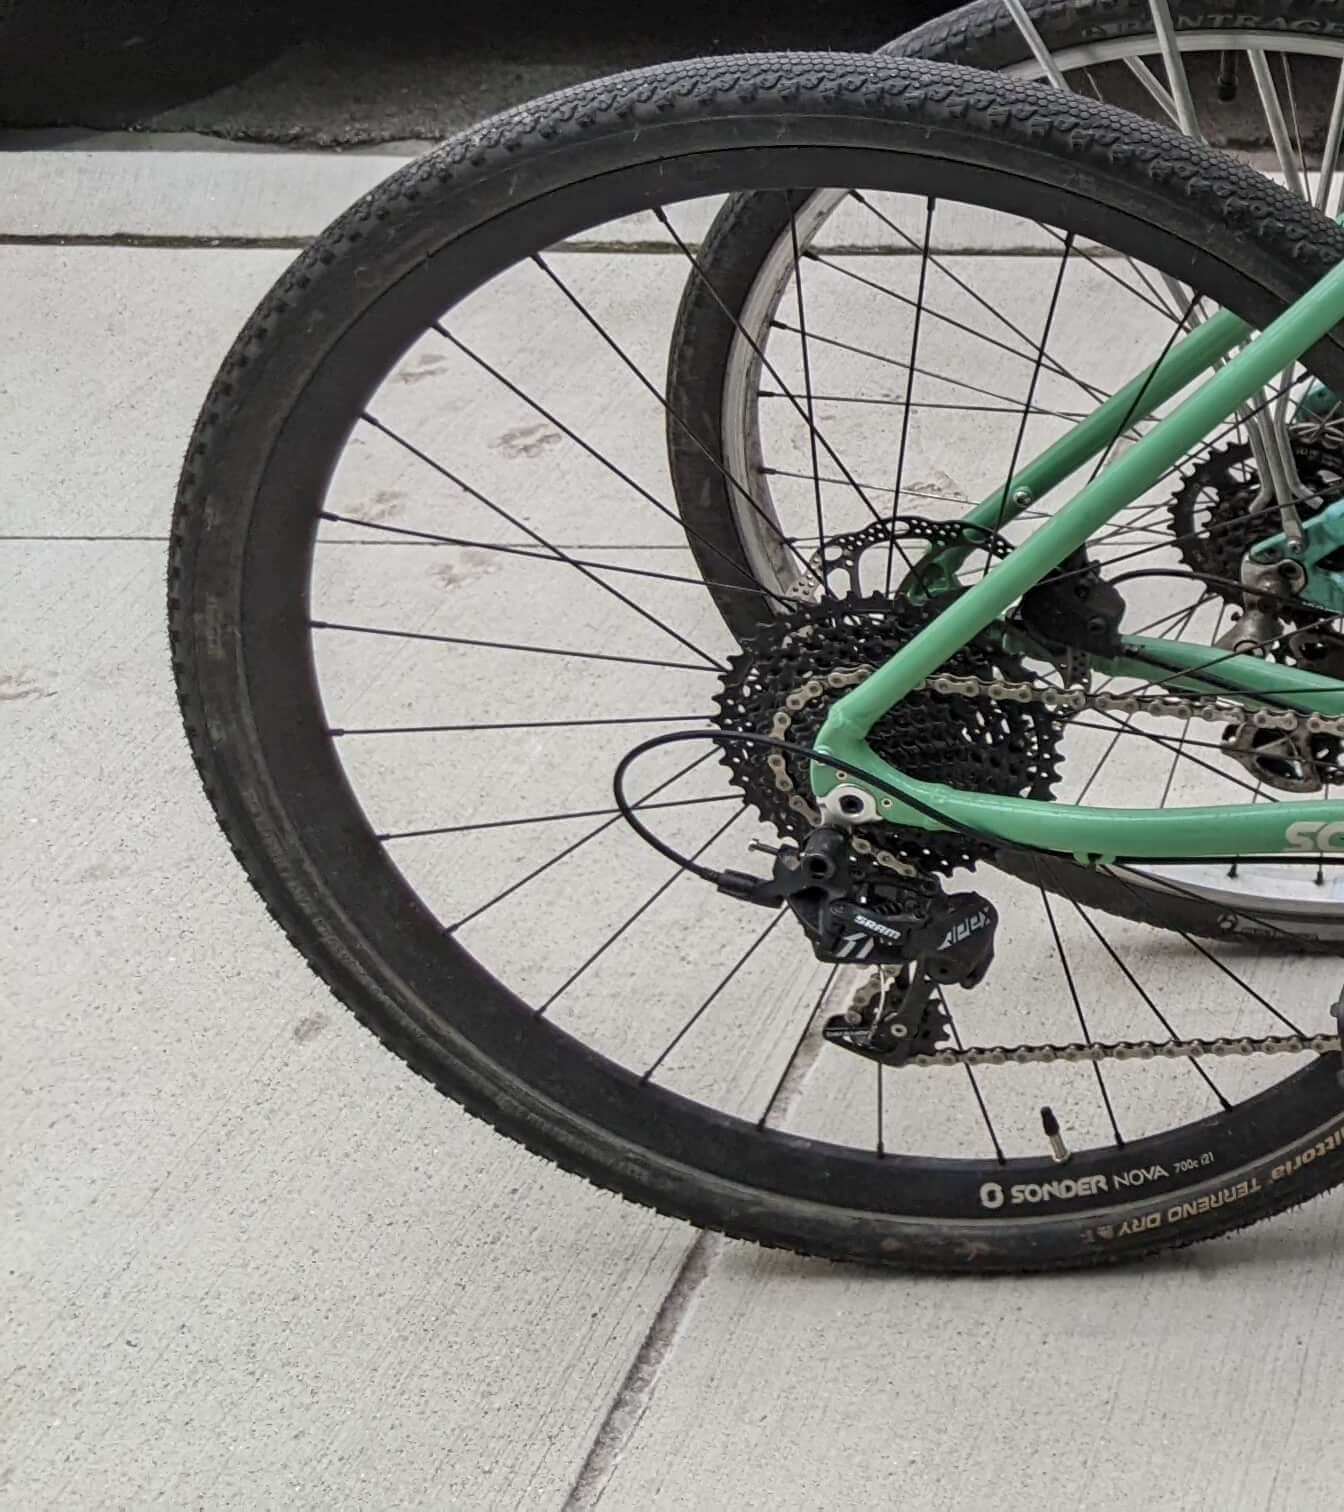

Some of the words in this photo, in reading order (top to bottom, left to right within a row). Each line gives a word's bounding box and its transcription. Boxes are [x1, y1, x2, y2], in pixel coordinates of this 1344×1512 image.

[854, 915, 901, 940] SRAM
[1011, 1175, 1108, 1205] SONDER
[1114, 1164, 1170, 1190] NOVA
[1167, 1178, 1262, 1223] TERRENO
[1118, 1212, 1160, 1237] DRY
